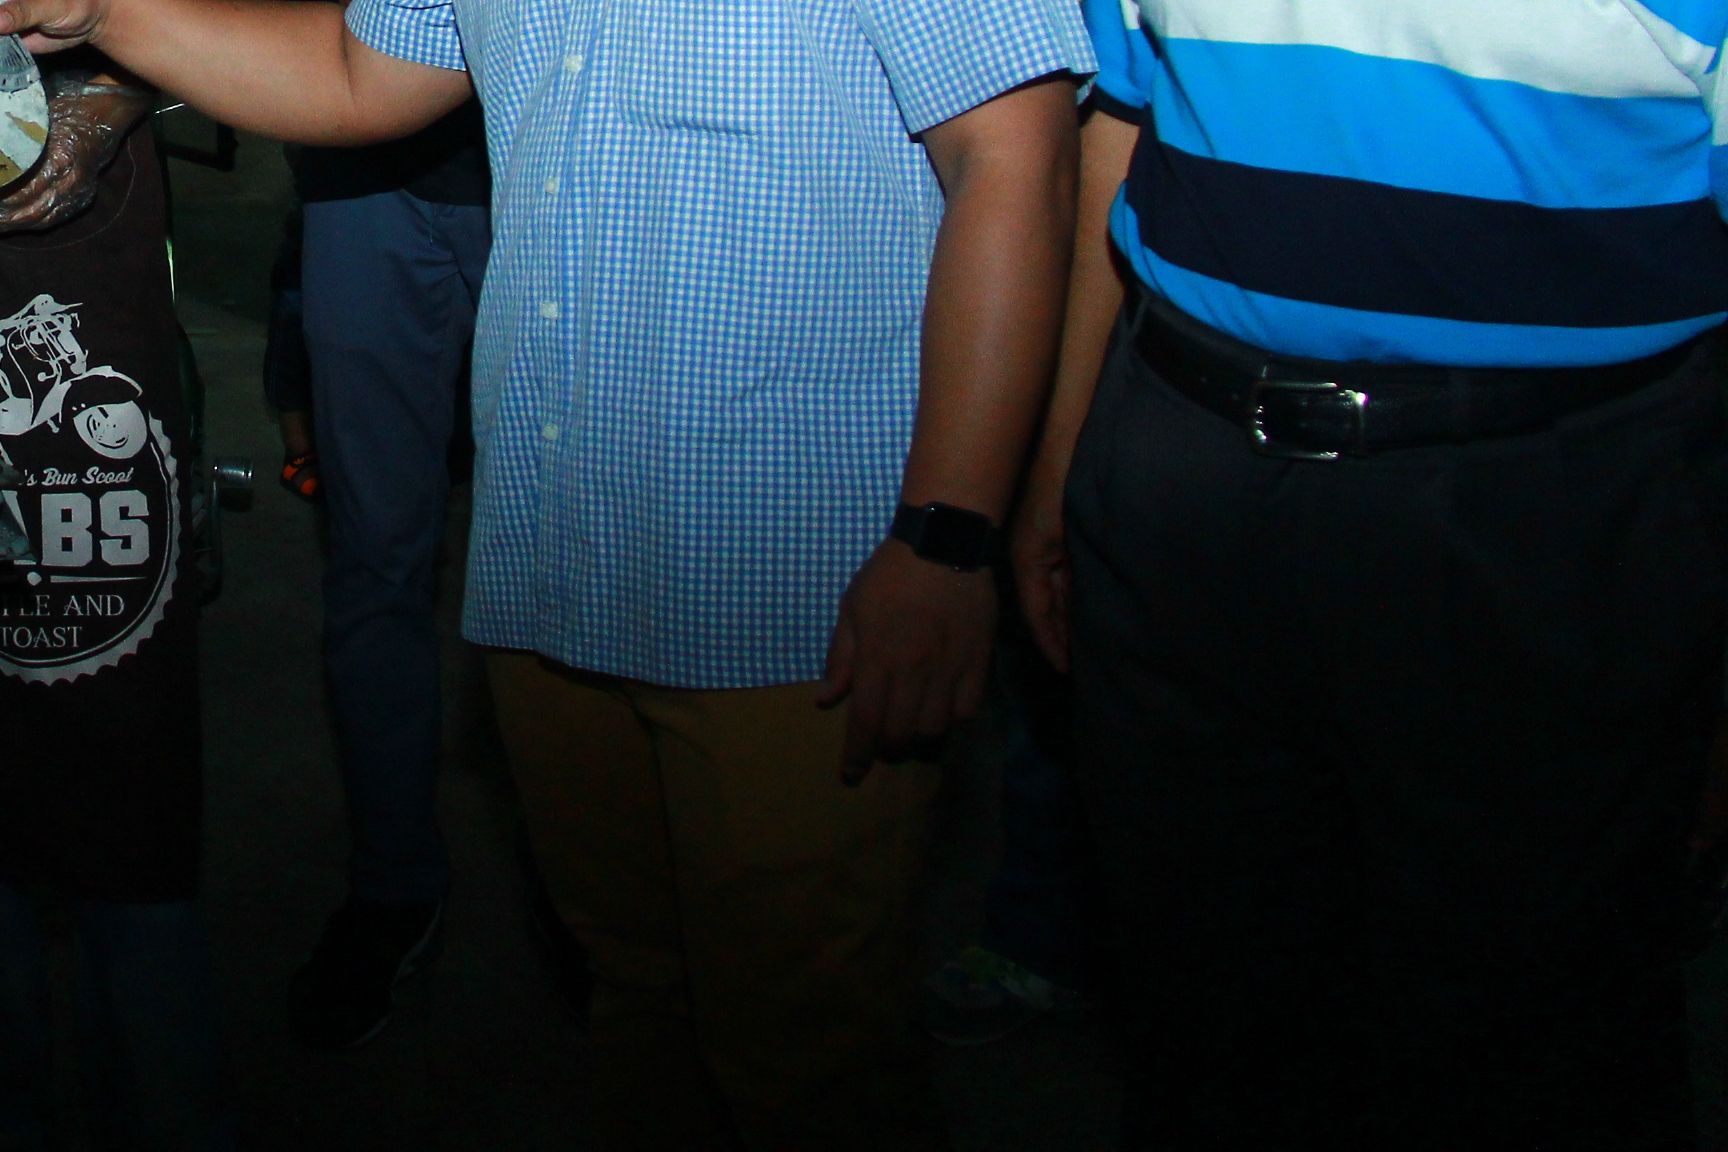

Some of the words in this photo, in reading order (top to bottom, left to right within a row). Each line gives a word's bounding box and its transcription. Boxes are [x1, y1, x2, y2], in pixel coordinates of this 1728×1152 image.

[41, 466, 78, 486] Bun
[81, 465, 135, 485] Scoot
[3, 489, 150, 568] BS
[63, 593, 126, 617] AND
